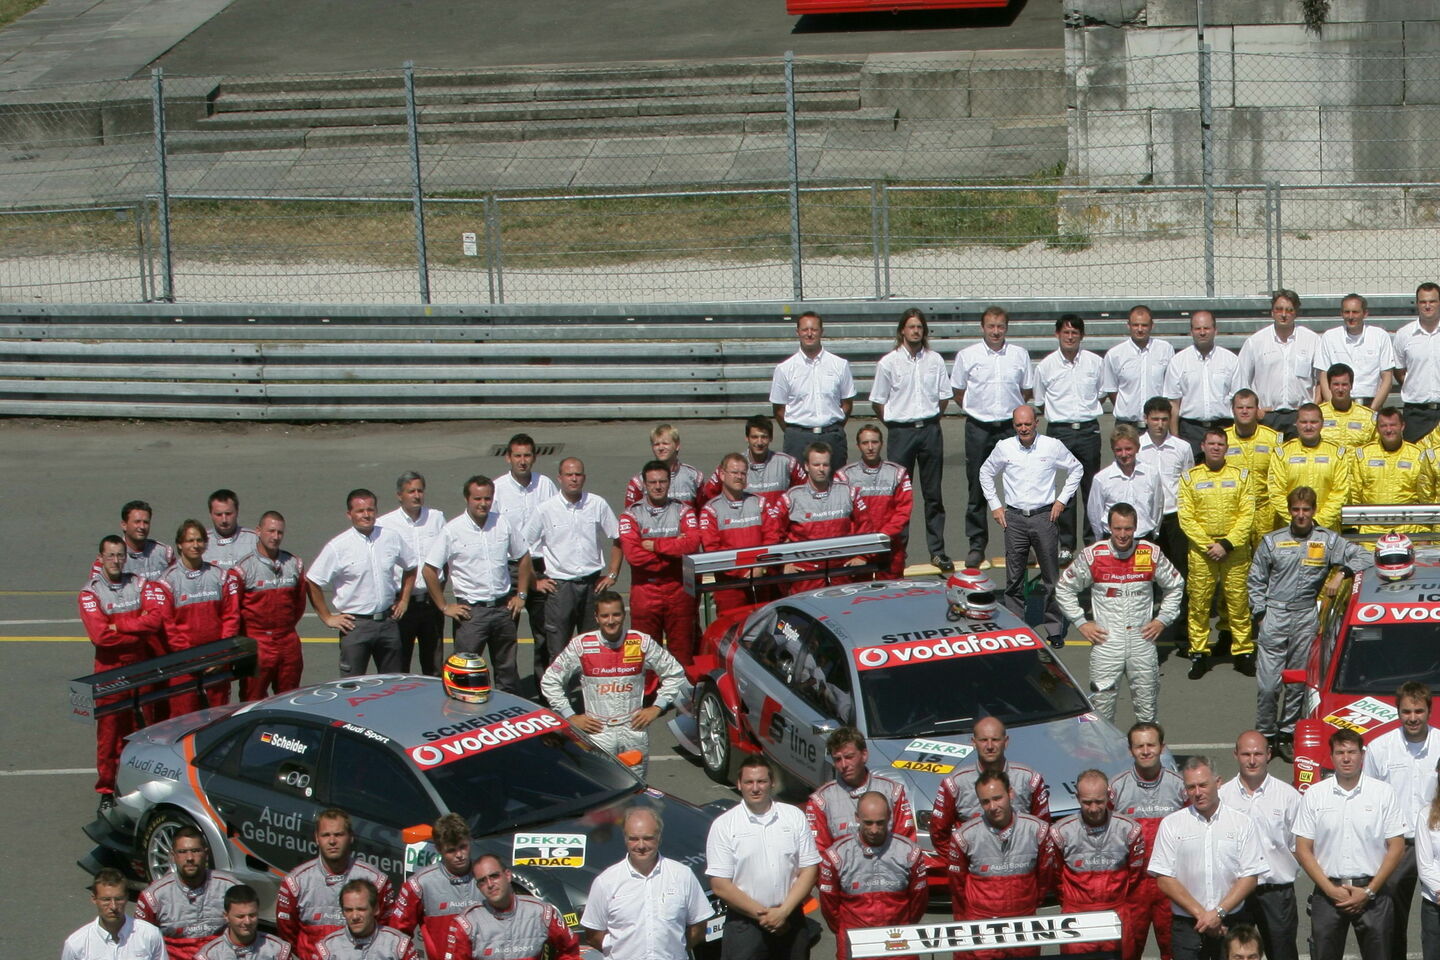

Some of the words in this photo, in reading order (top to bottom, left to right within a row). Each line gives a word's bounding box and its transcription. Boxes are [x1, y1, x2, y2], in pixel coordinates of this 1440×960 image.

[1127, 572, 1145, 581] Sport
[881, 622, 1004, 645] STIPPLER
[890, 632, 1036, 662] vodafone
[1344, 711, 1372, 725] 20
[1353, 699, 1398, 721] DEKRA
[342, 722, 365, 735] Audi
[364, 728, 392, 744] Sport
[422, 705, 531, 742] SCHEIDER
[441, 712, 562, 757] vodafone
[271, 733, 308, 755] Scheider
[790, 726, 818, 764] line
[908, 740, 972, 757] DEKRA
[127, 755, 154, 771] Audi
[154, 761, 183, 781] Bank
[902, 761, 943, 774] ADAC
[917, 752, 943, 763] 15
[259, 805, 302, 832] Audi
[516, 835, 582, 846] DEKRA
[526, 856, 572, 867] ADAC
[538, 847, 571, 859] 16
